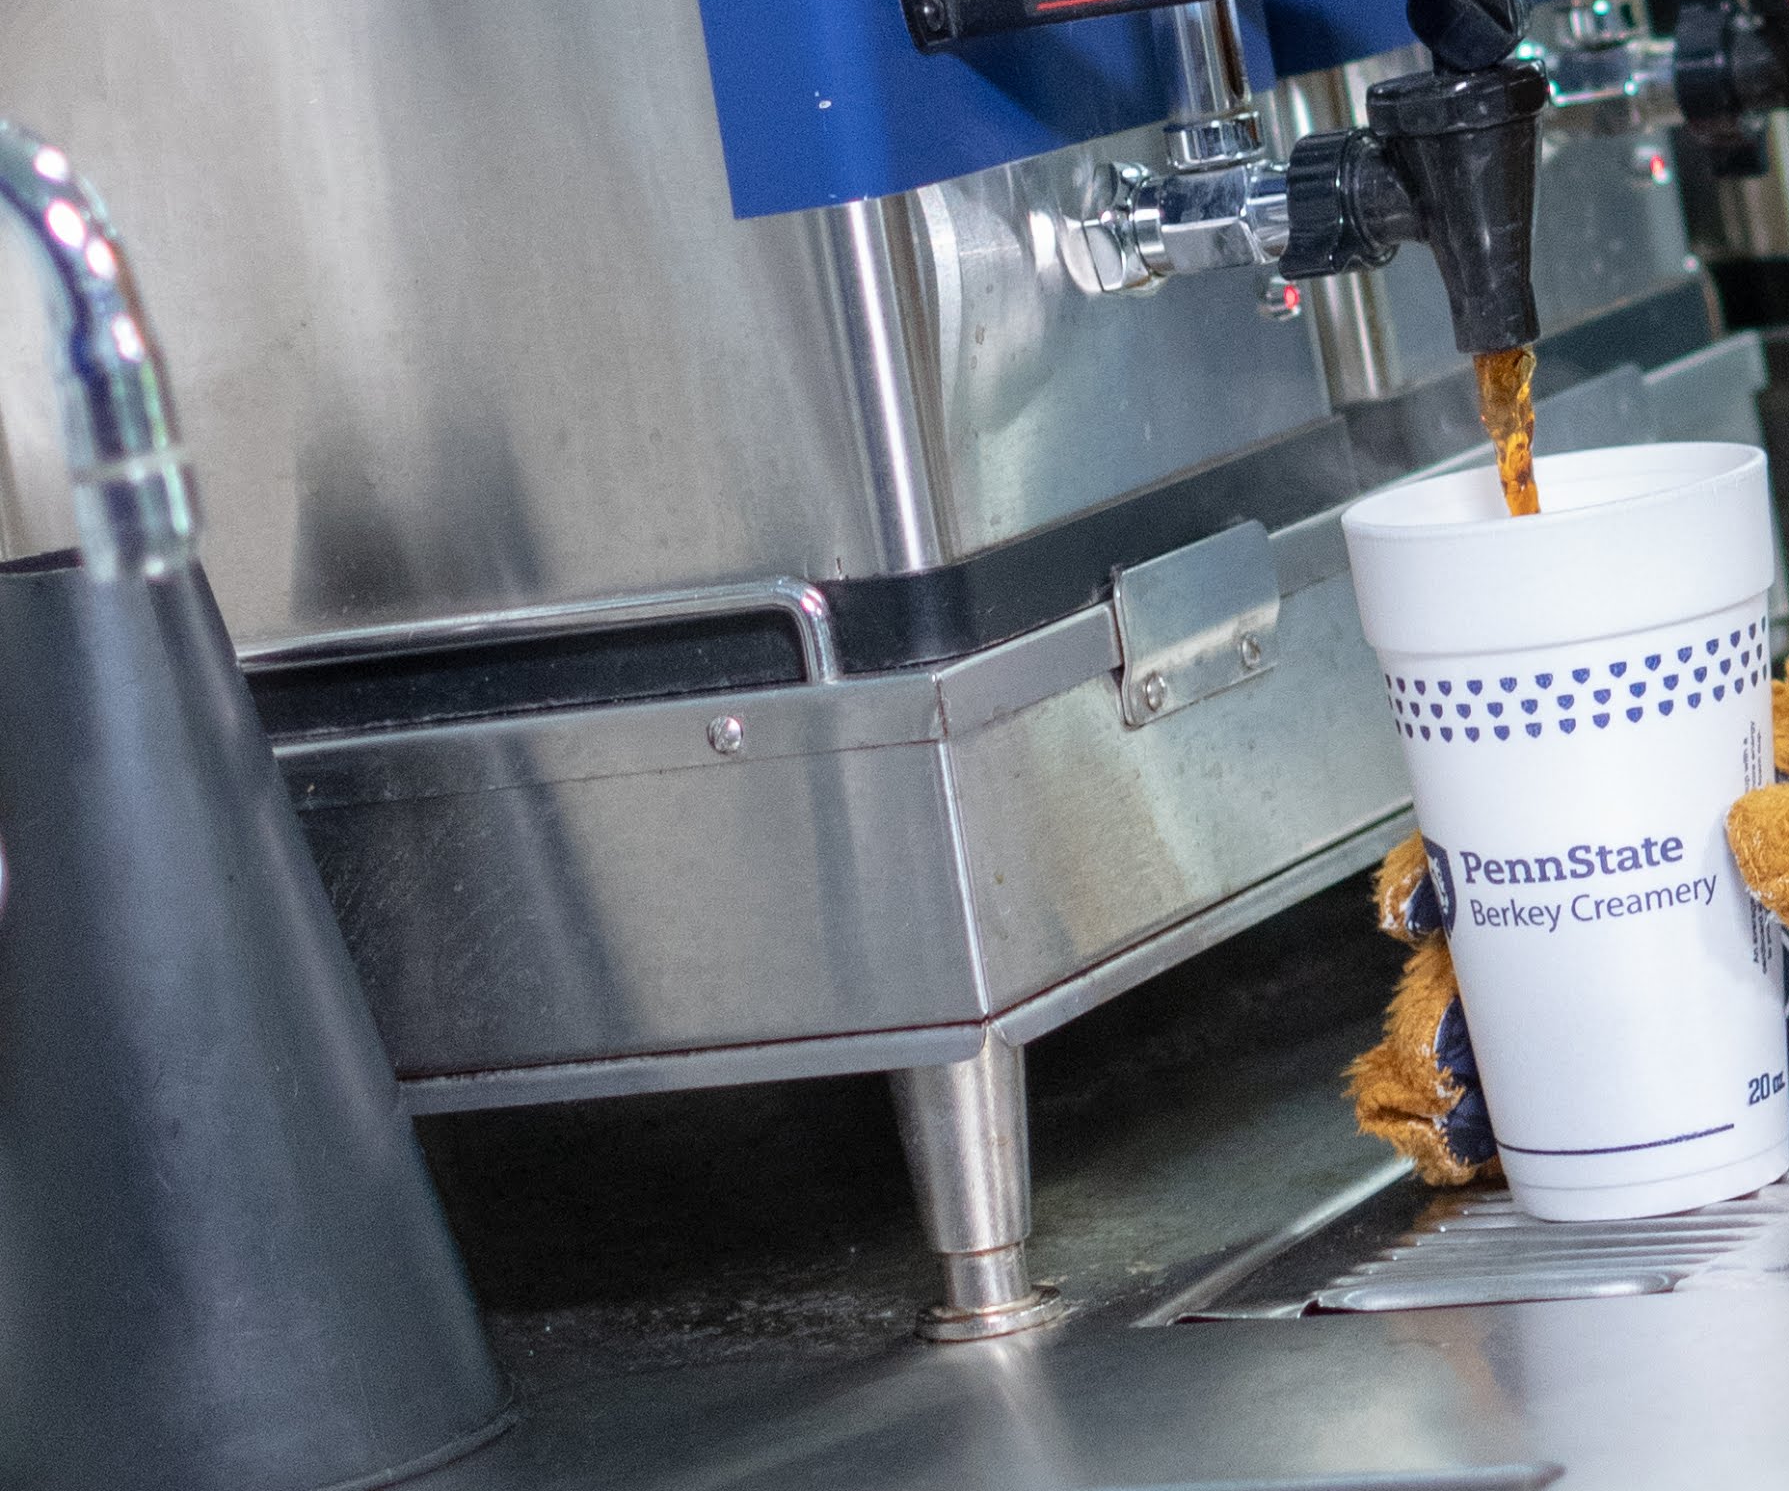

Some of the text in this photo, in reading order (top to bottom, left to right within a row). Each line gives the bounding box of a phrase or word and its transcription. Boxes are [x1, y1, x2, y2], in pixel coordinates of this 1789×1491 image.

[1459, 834, 1685, 886] PennState
[1470, 874, 1718, 933] Berkey Creamery
[1748, 1072, 1770, 1107] 20
